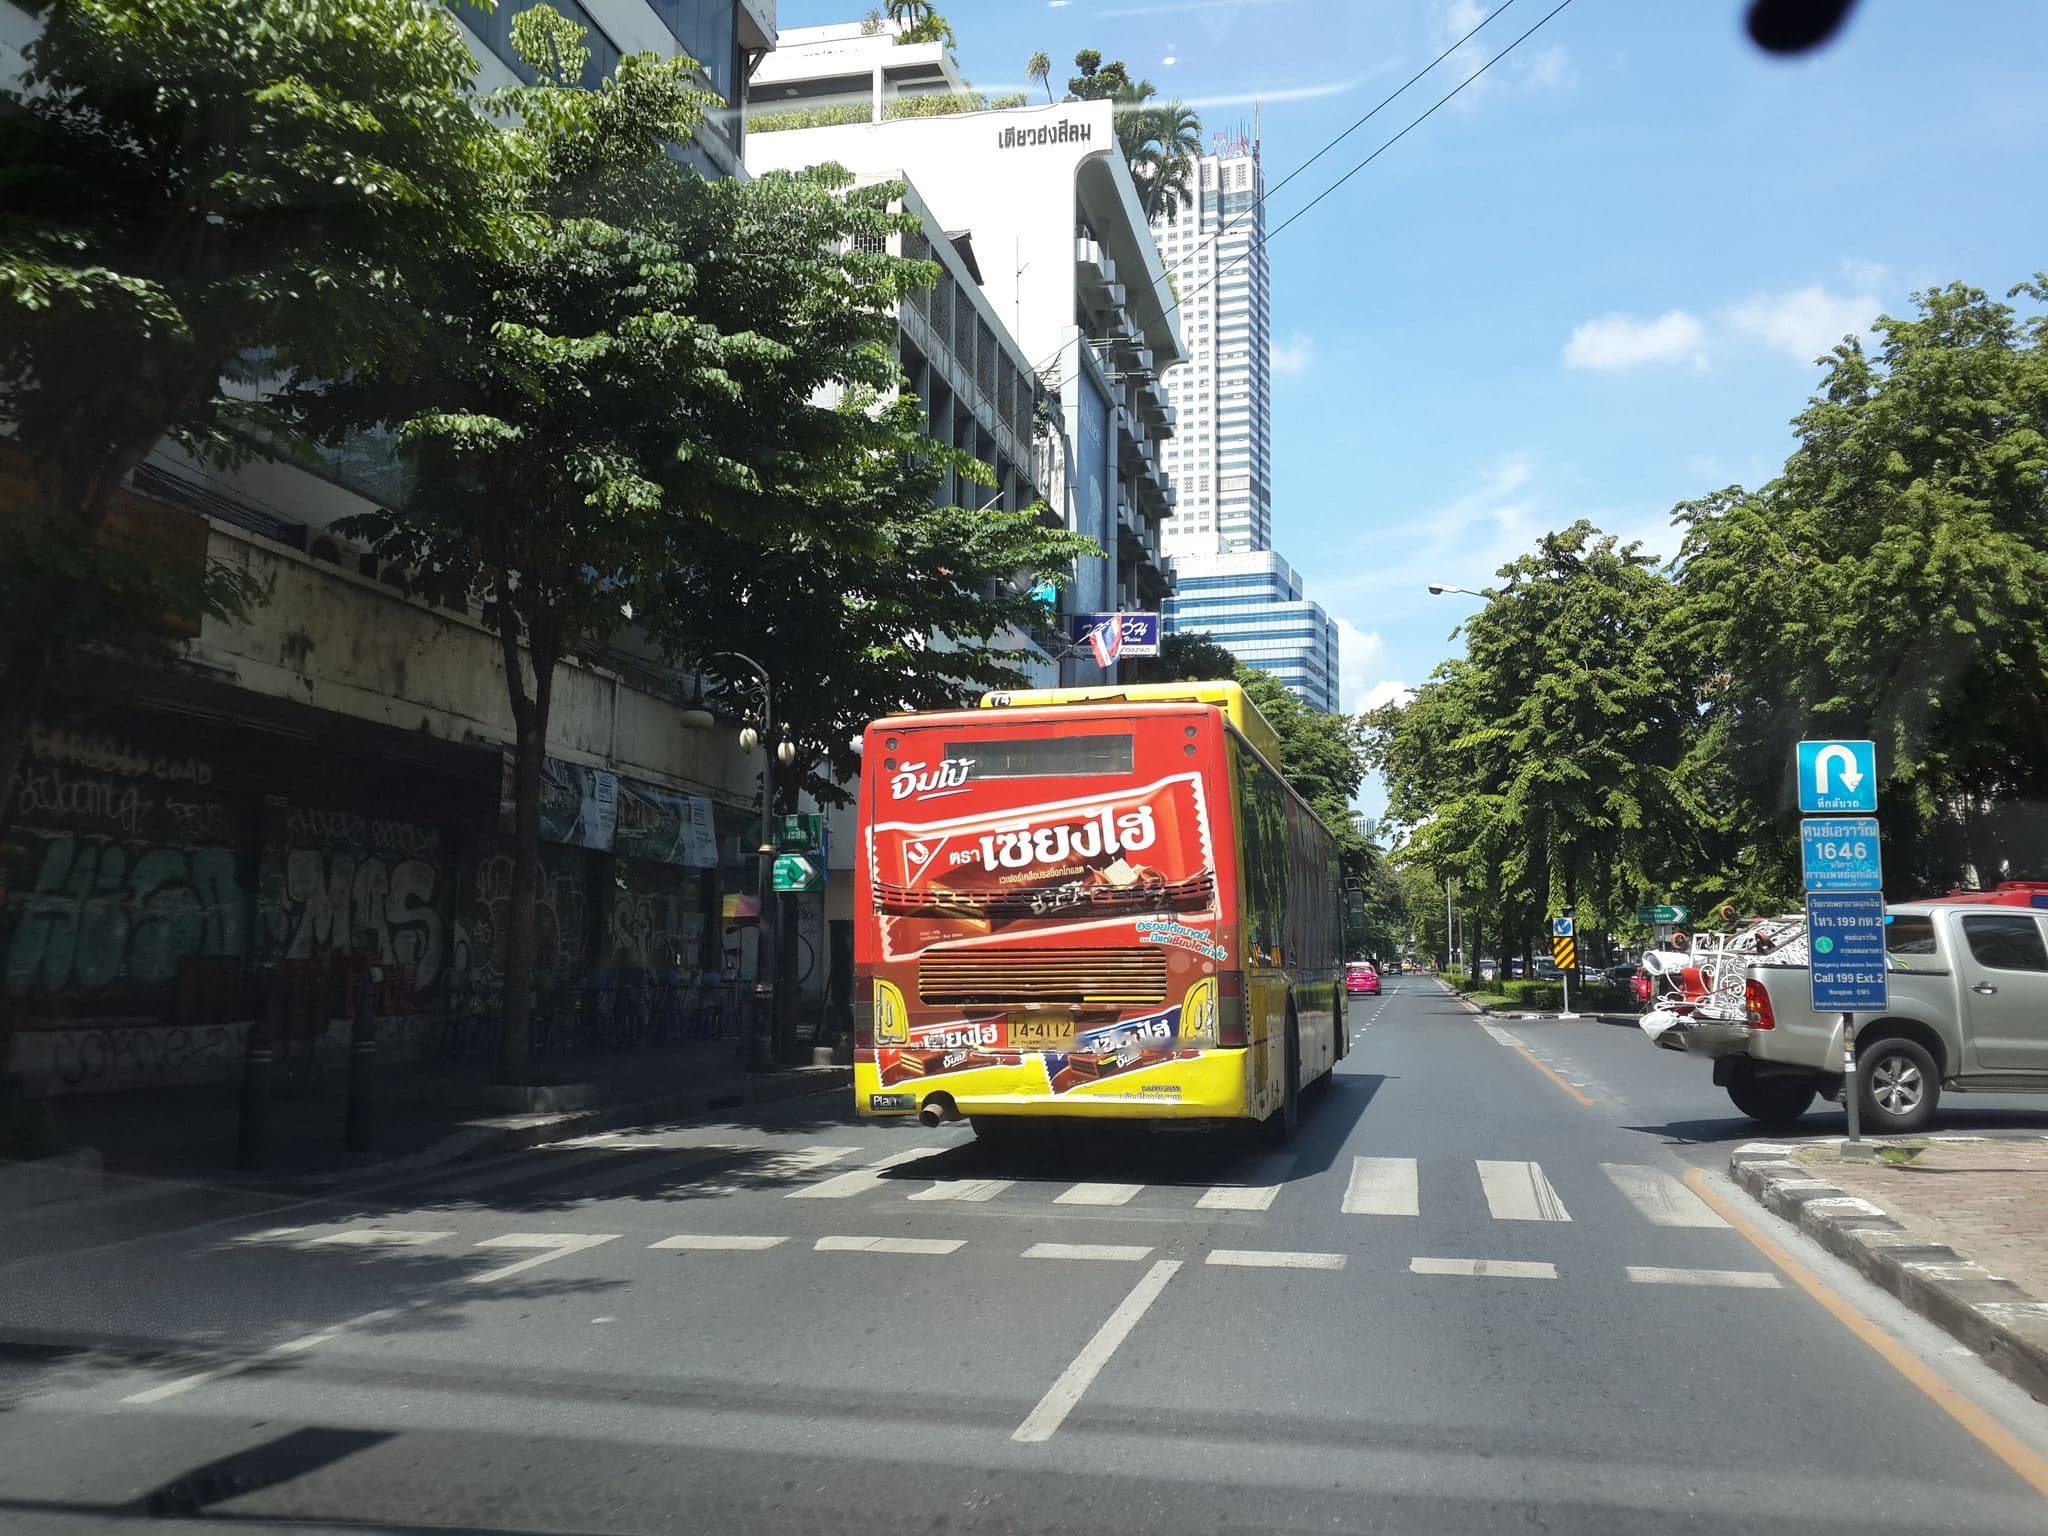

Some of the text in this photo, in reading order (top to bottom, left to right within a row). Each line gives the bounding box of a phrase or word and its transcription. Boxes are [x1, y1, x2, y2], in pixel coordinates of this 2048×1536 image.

[891, 757, 976, 800] จัมโบ้
[949, 805, 1157, 871] ตรา เซียงไฮ
[1803, 822, 1878, 842] ศูนย์เอราวัณ
[1815, 842, 1867, 860] 1646
[1875, 917, 1883, 927] 2
[1814, 973, 1834, 983] Call
[1836, 973, 1854, 983] 199
[1013, 1021, 1071, 1038] 14-4112
